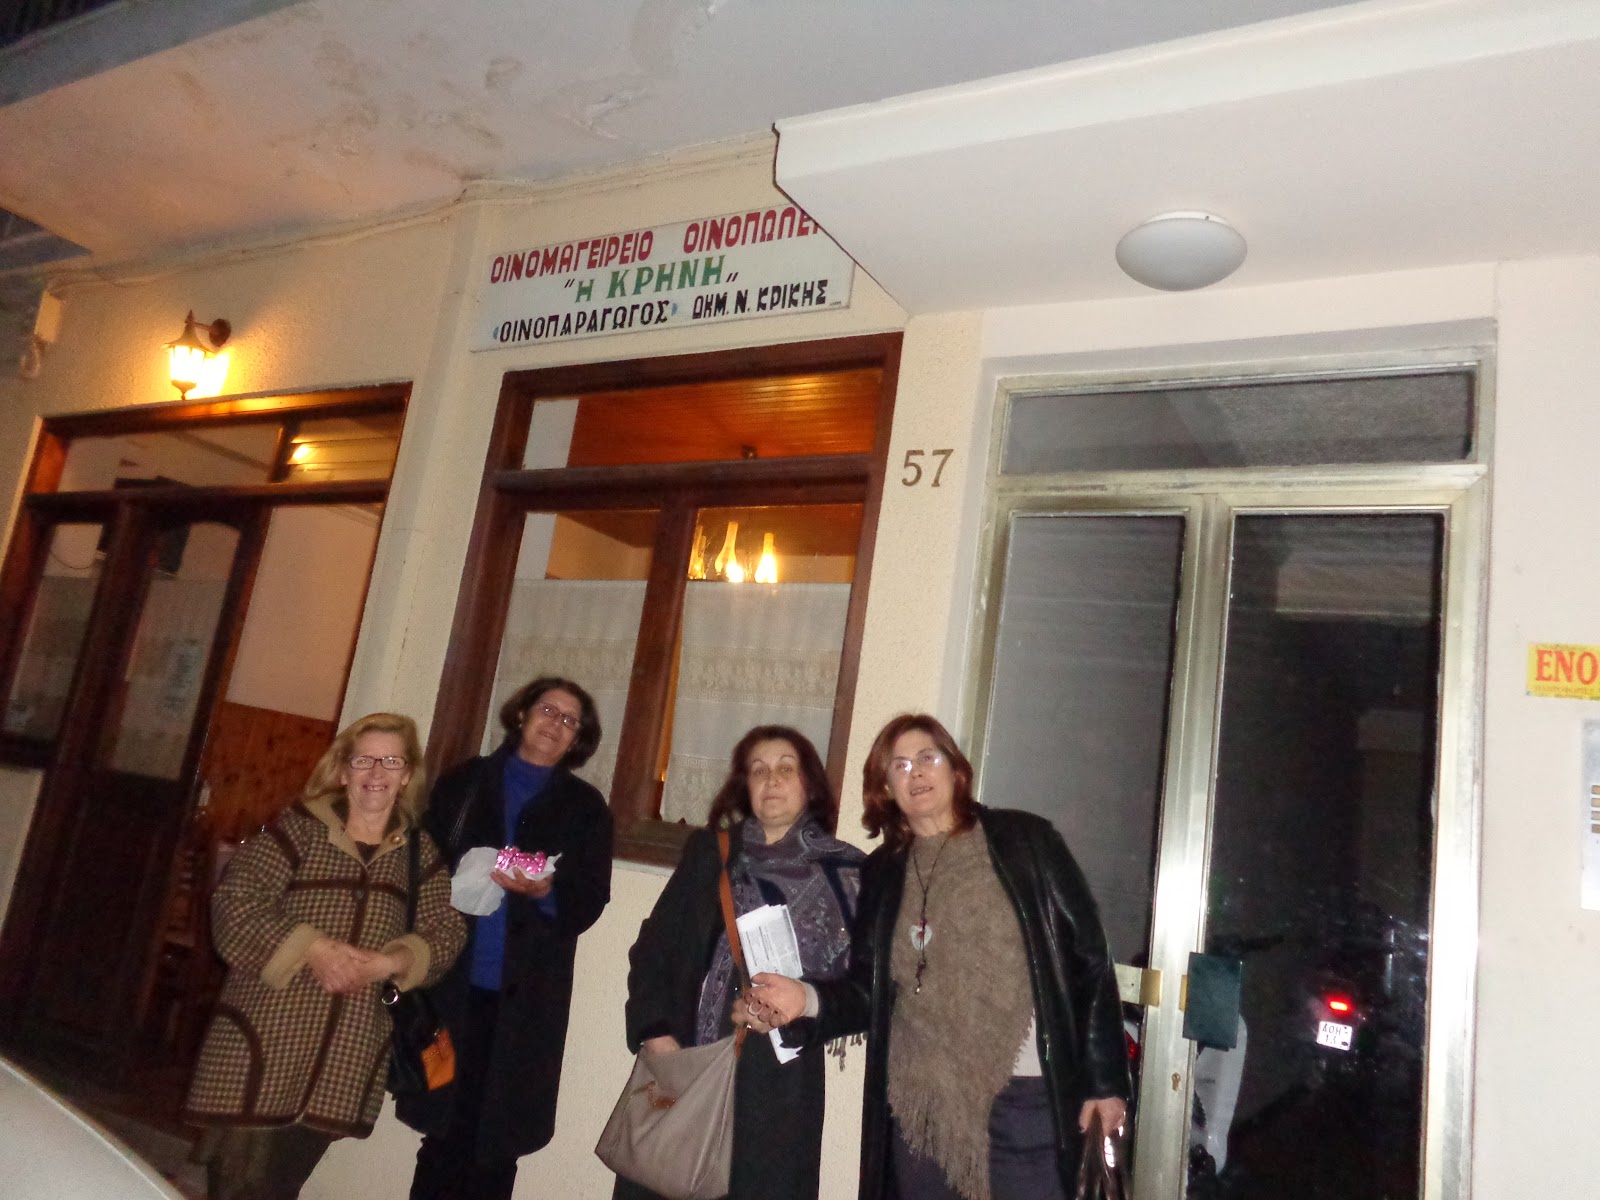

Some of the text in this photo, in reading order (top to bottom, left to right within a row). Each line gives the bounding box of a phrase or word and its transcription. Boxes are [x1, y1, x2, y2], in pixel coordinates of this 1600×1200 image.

[490, 230, 654, 284] ΟΙΝΟΜΑΓΕΙΡΕΙΟ
[756, 279, 828, 312] ΚΡΙΚΗΣ
[901, 448, 954, 487] 57
